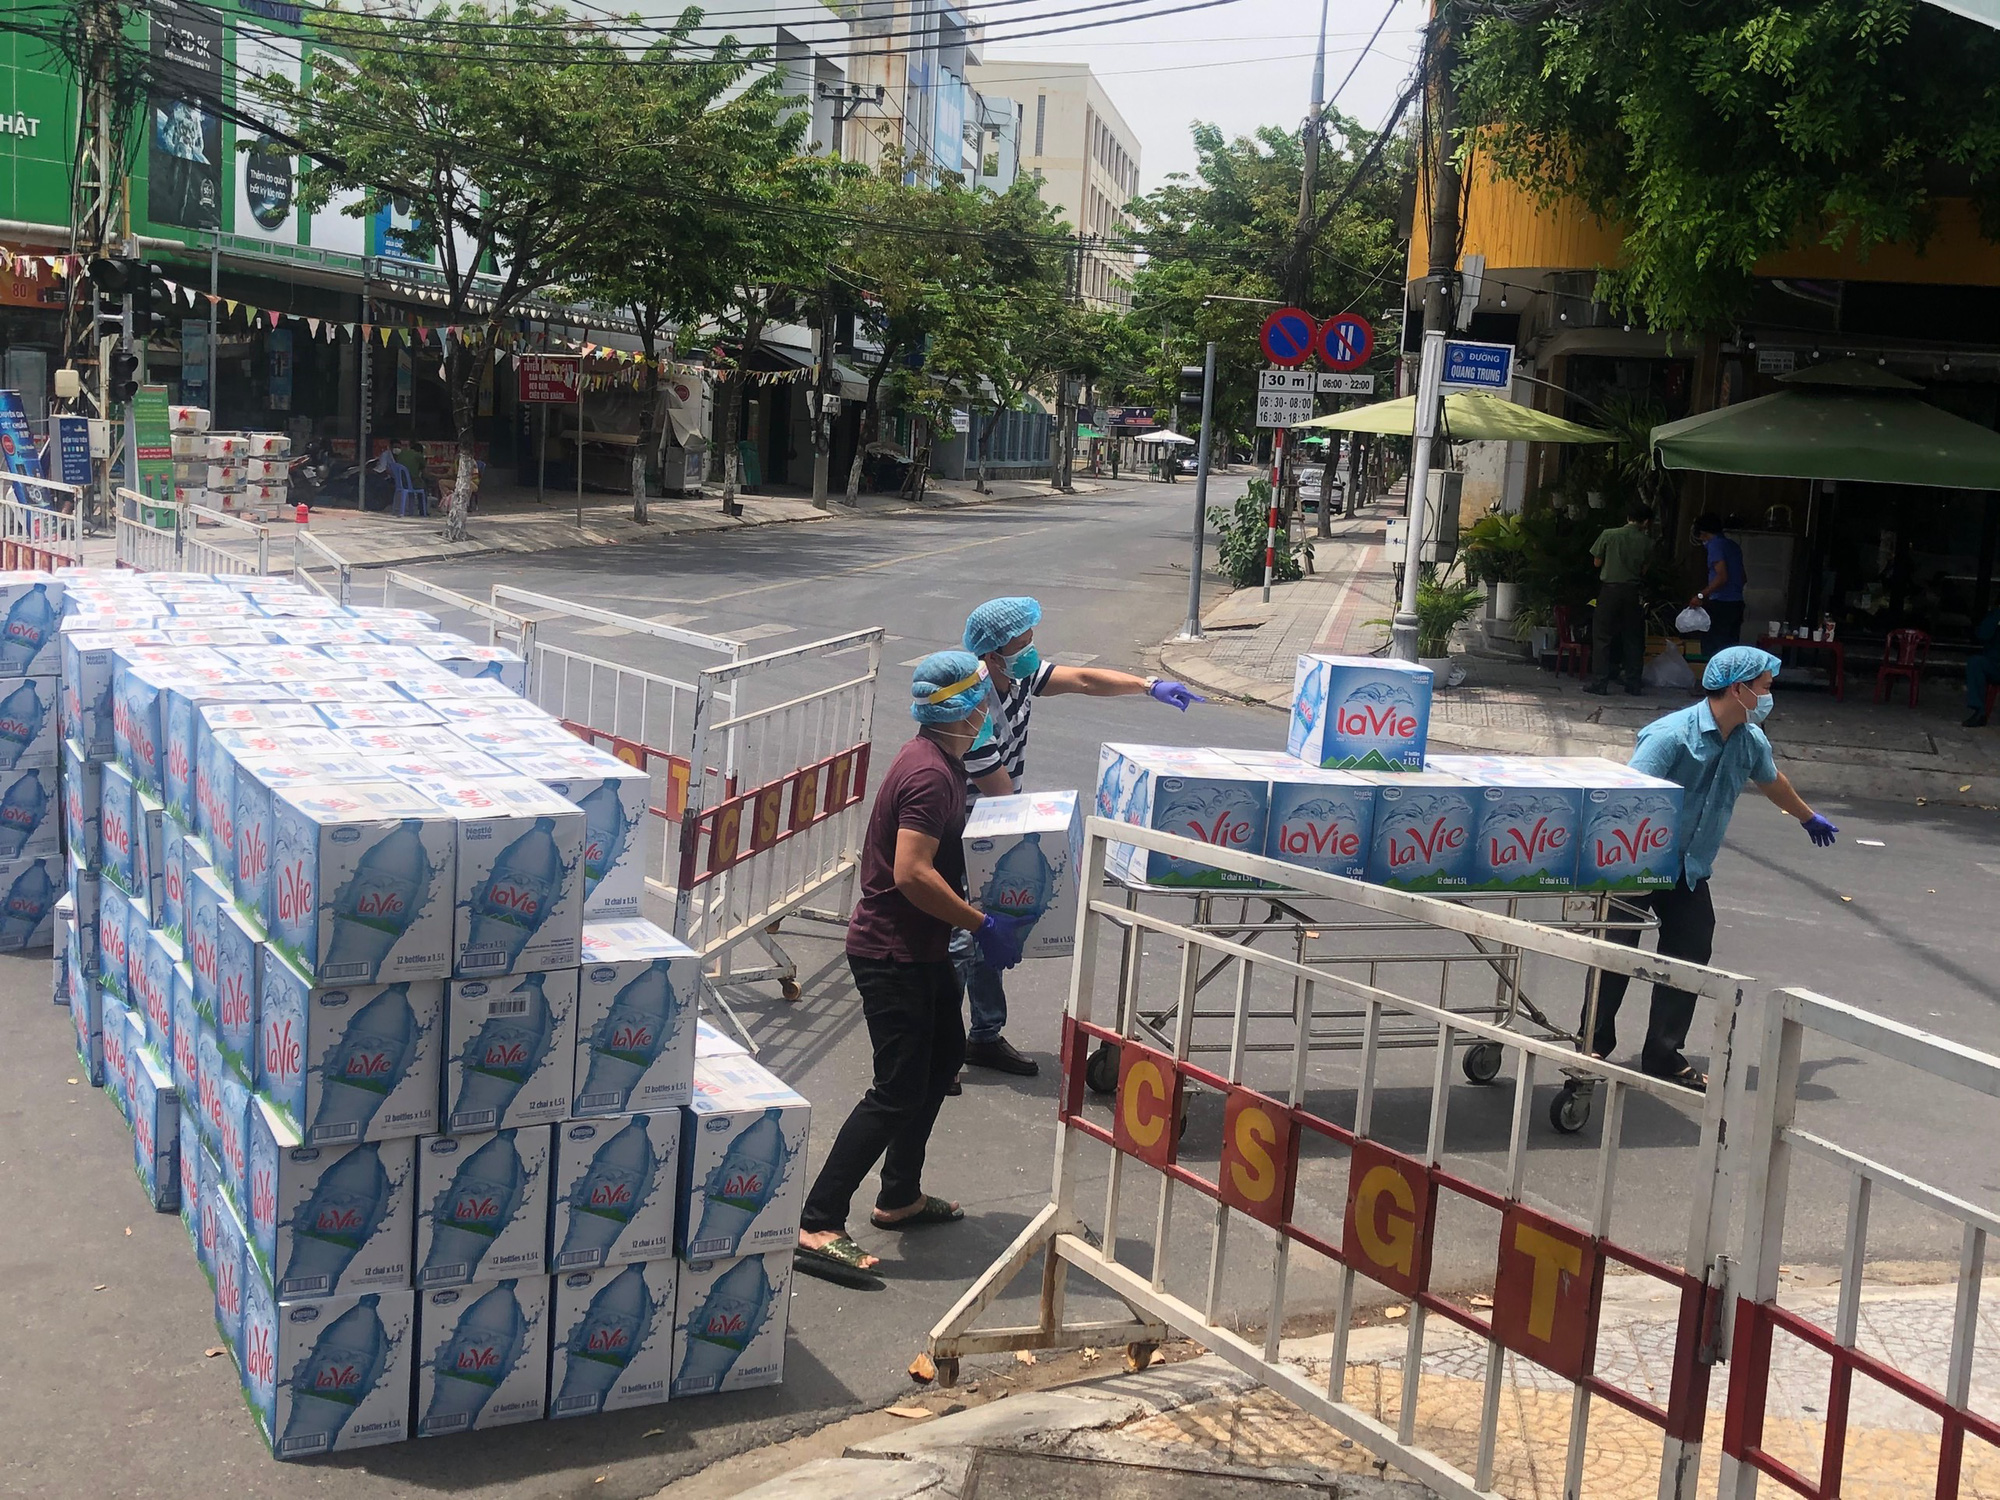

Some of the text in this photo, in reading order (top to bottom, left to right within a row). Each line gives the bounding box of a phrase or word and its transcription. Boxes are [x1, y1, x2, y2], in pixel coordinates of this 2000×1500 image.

[12, 283, 27, 298] 80
[1469, 352, 1500, 363] ĐƯỜNG
[1451, 365, 1501, 382] QUANG TRUNG
[1268, 375, 1305, 387] 30 m
[1322, 379, 1342, 389] 06:00
[1350, 380, 1370, 390] 22:00
[397, 956, 404, 965] 12
[404, 954, 426, 964] bottles
